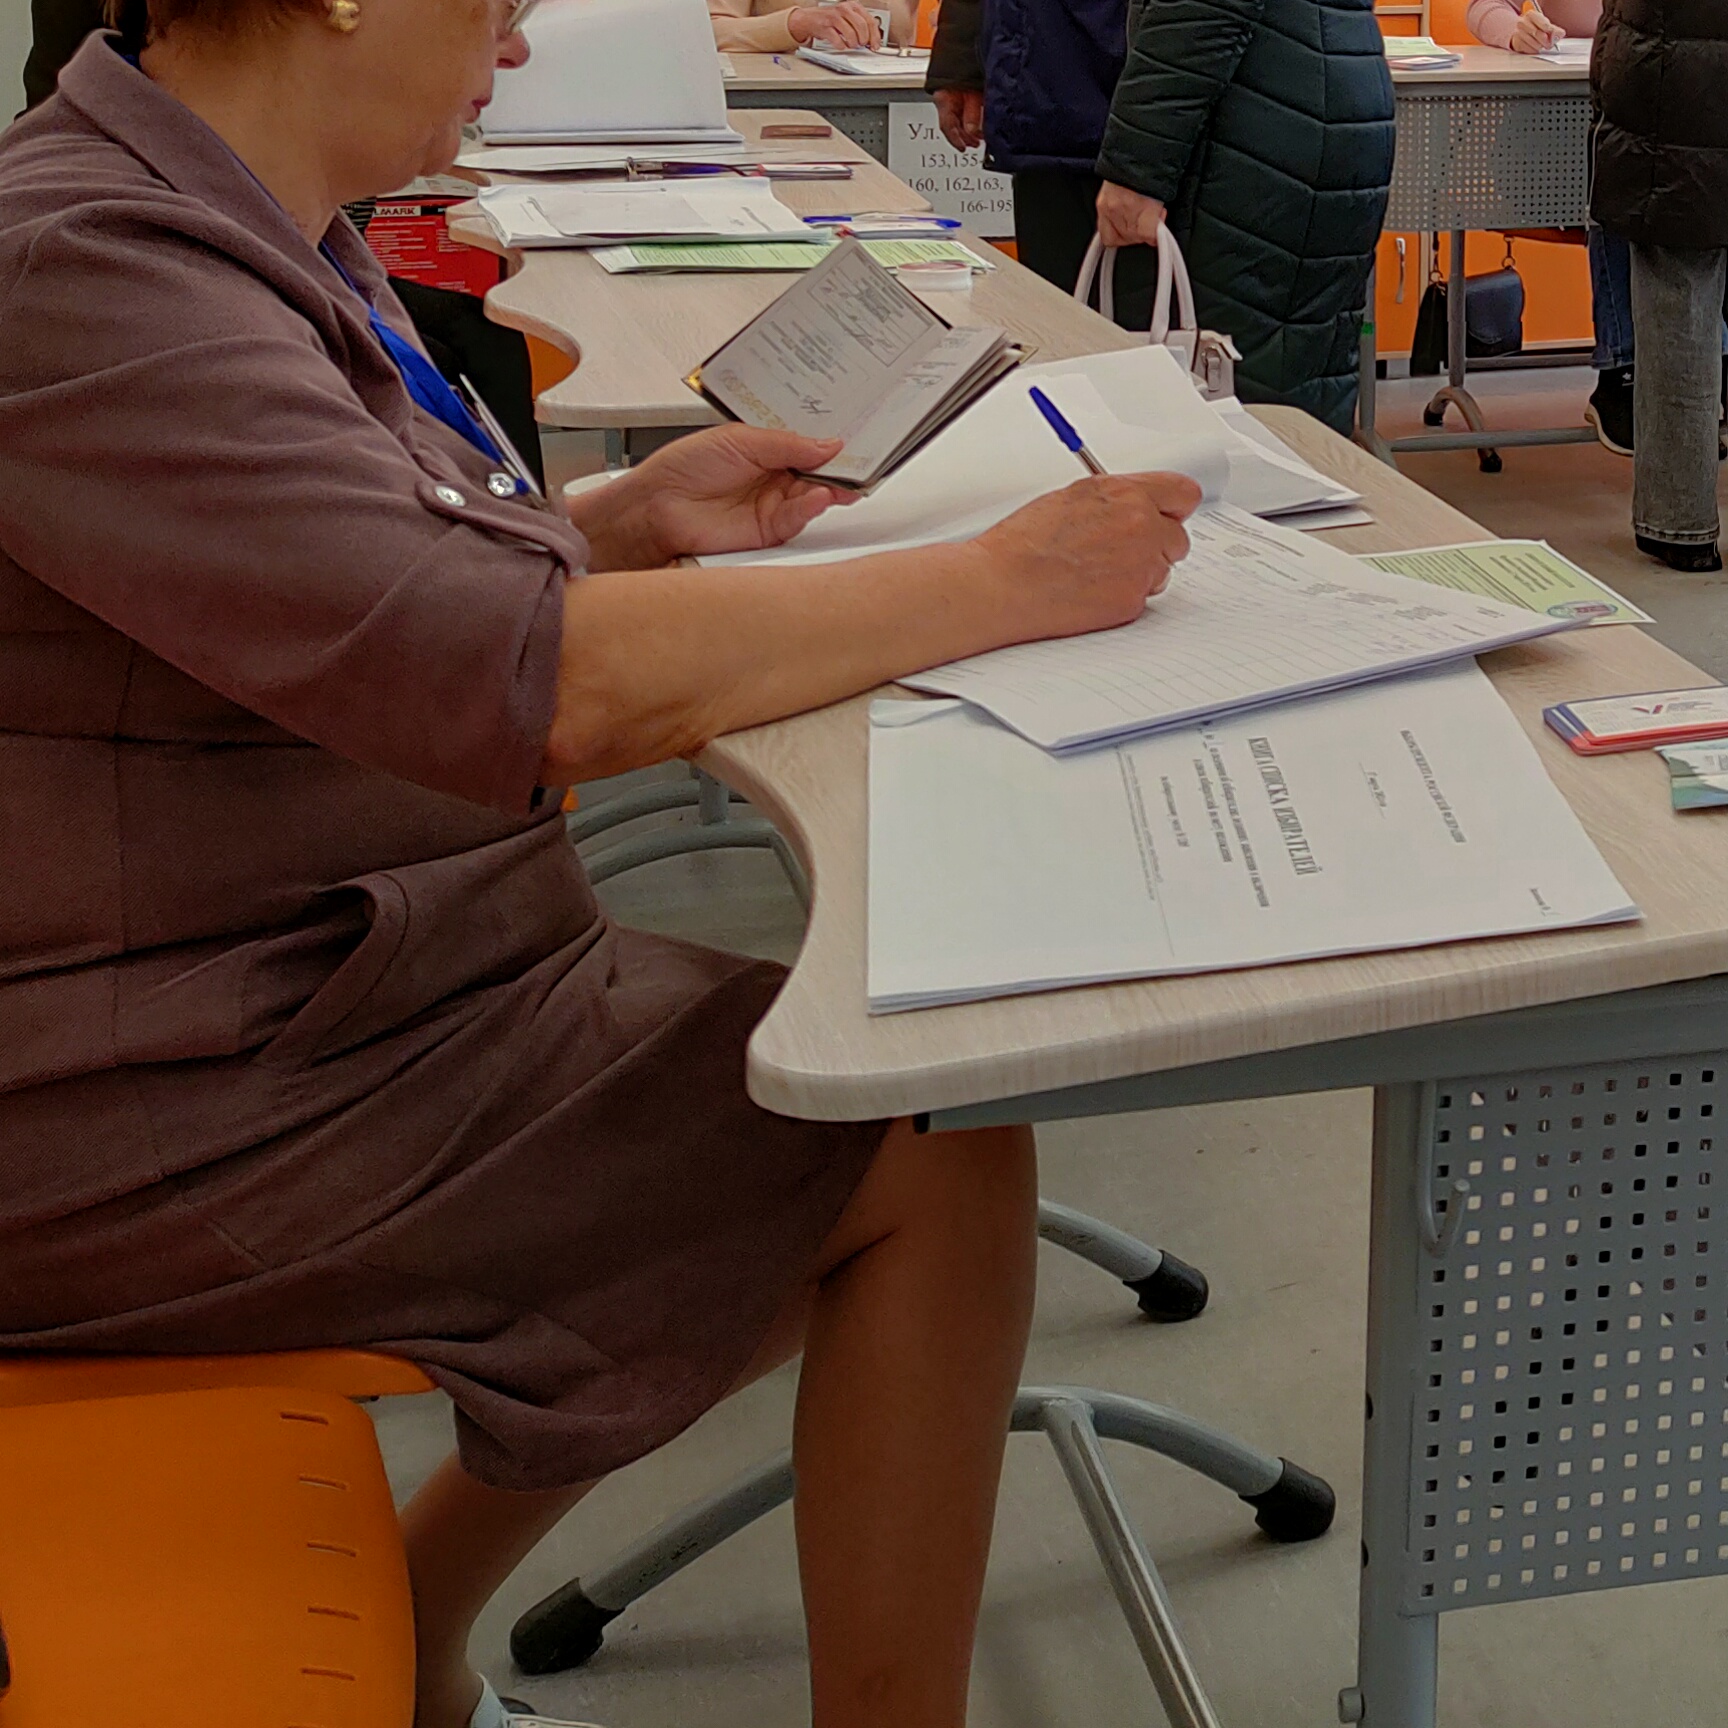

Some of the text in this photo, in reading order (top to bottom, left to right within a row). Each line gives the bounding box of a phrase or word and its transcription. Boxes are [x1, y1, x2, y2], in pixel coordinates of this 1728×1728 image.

[908, 123, 940, 140] Ул.
[960, 200, 1012, 213] 166-195
[1271, 805, 1324, 875] ИЗБИРАТЕЛЕЙ
